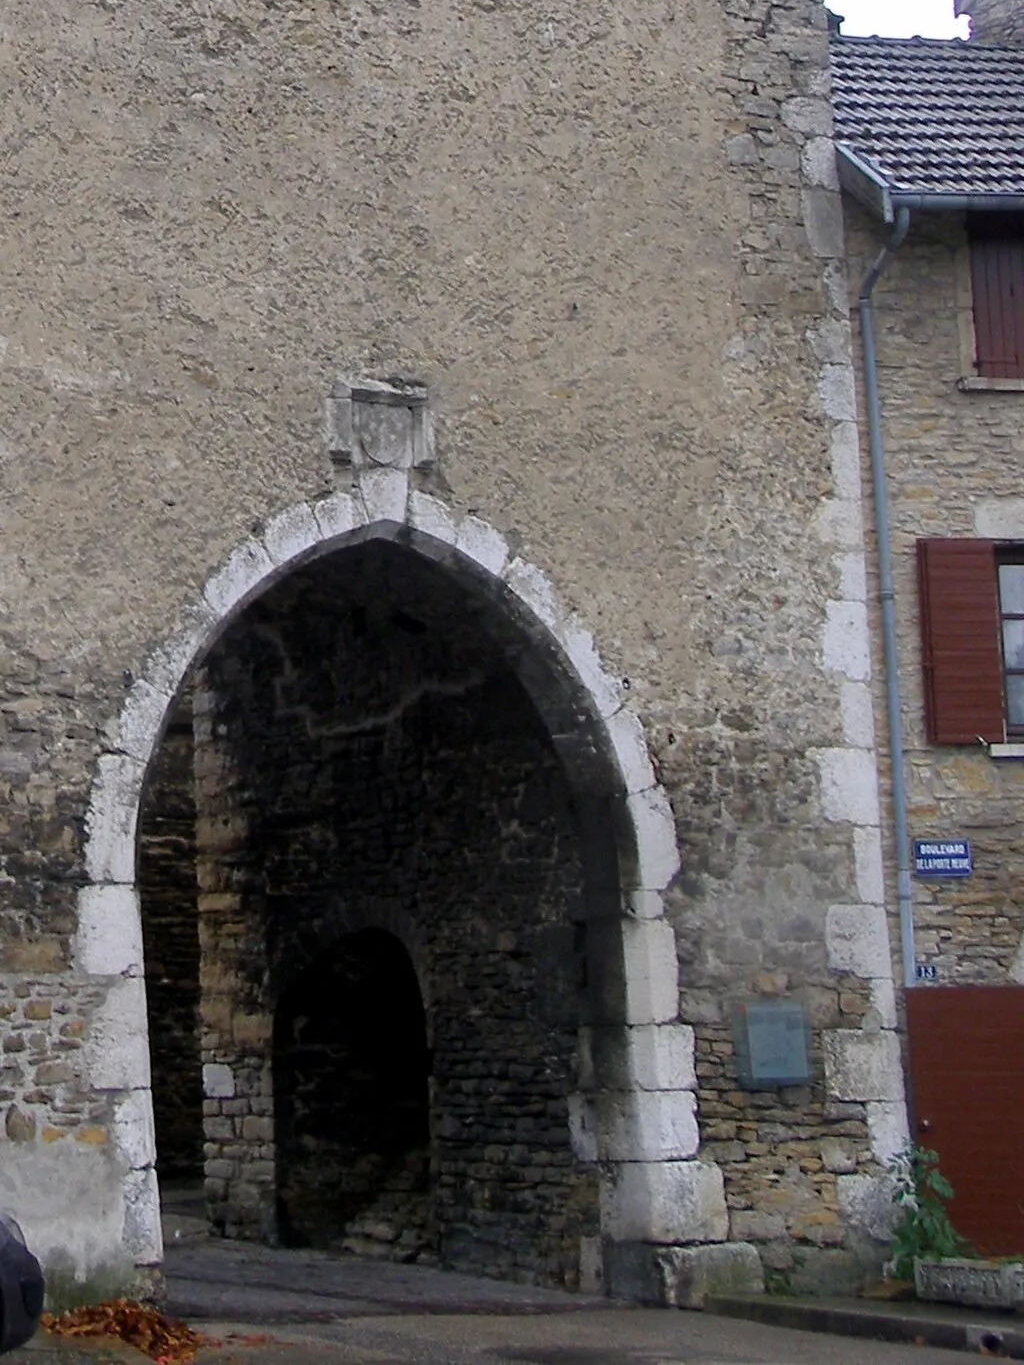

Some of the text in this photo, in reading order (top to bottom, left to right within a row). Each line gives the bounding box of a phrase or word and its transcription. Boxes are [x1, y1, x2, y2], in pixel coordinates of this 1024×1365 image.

[920, 844, 965, 855] BOULEVARD
[916, 858, 969, 869] DE LA PORTE NEUVE
